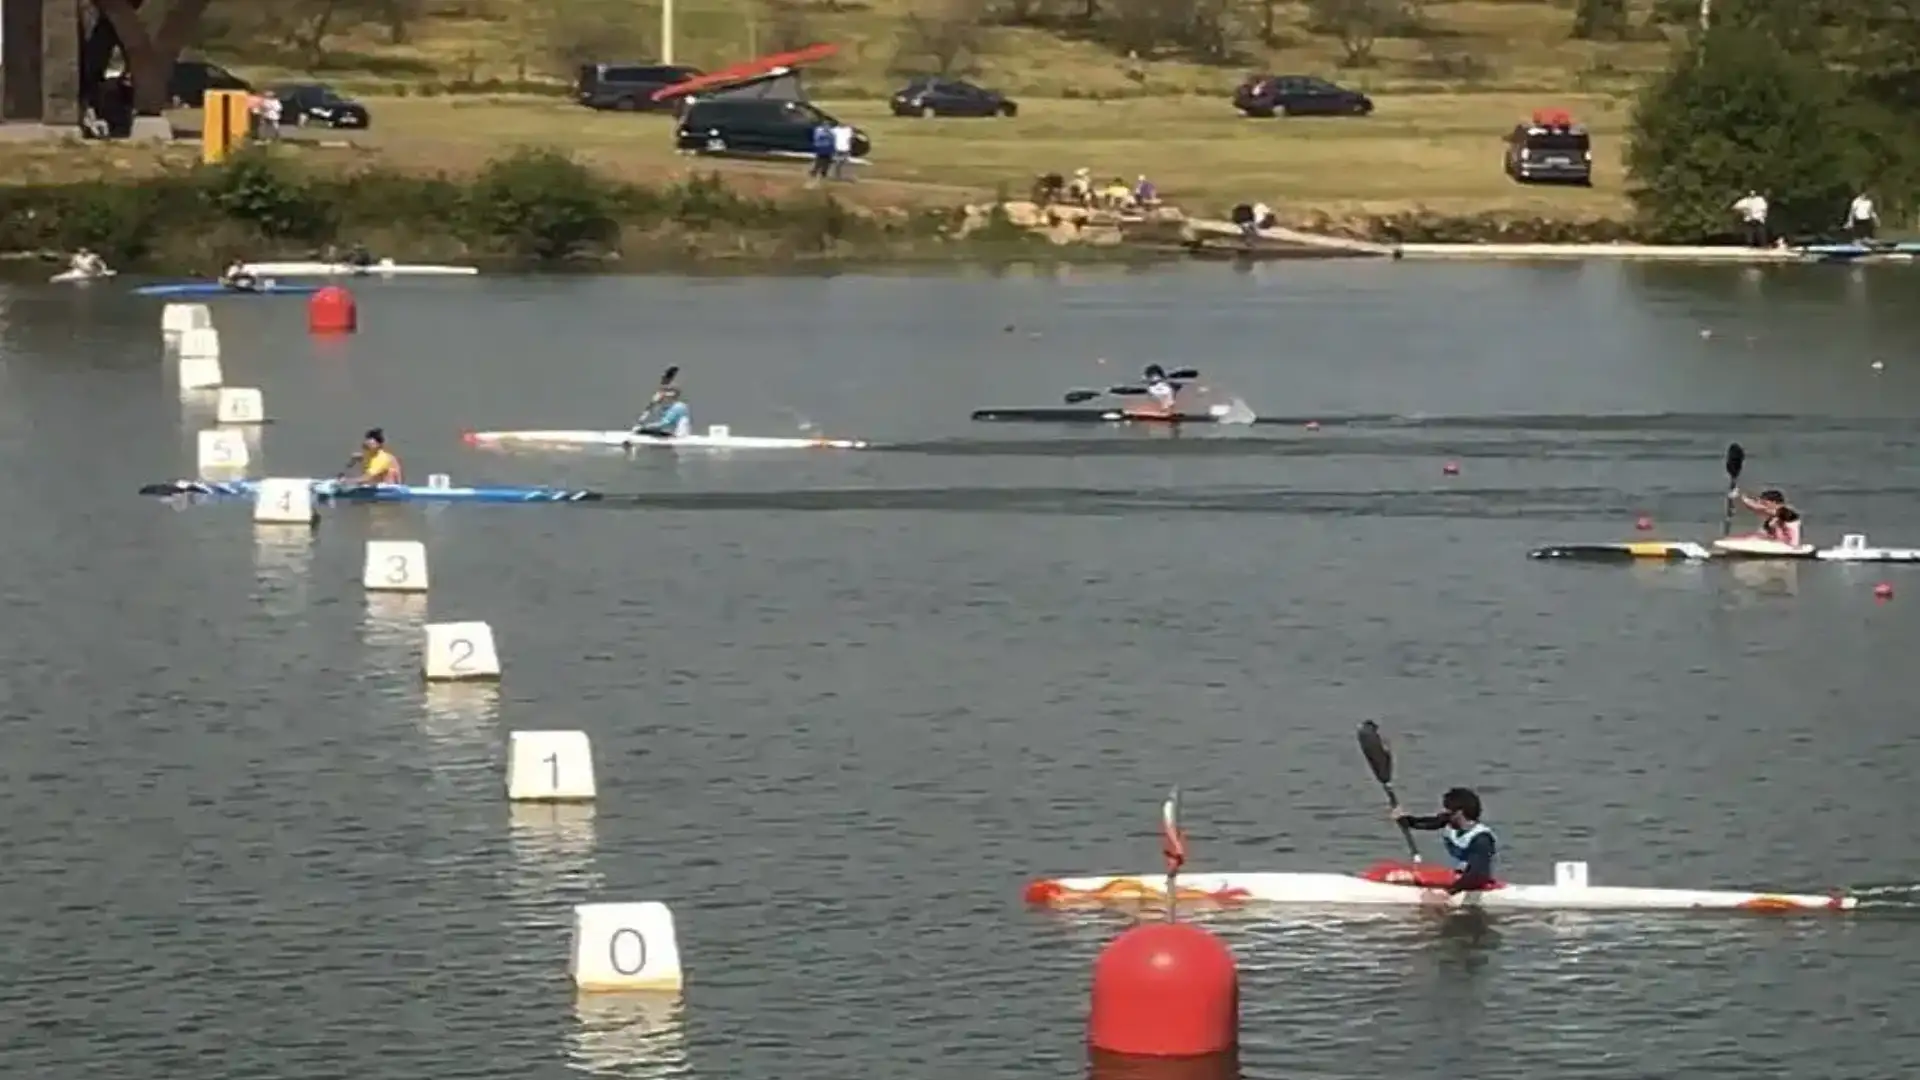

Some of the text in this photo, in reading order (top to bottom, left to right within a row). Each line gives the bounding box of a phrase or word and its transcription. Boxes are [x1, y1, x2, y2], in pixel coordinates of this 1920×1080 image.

[214, 440, 232, 460] 5
[275, 491, 293, 513] 4
[386, 555, 409, 584] 3
[448, 638, 476, 672] 2
[543, 752, 558, 790] 1
[610, 928, 647, 976] 0
